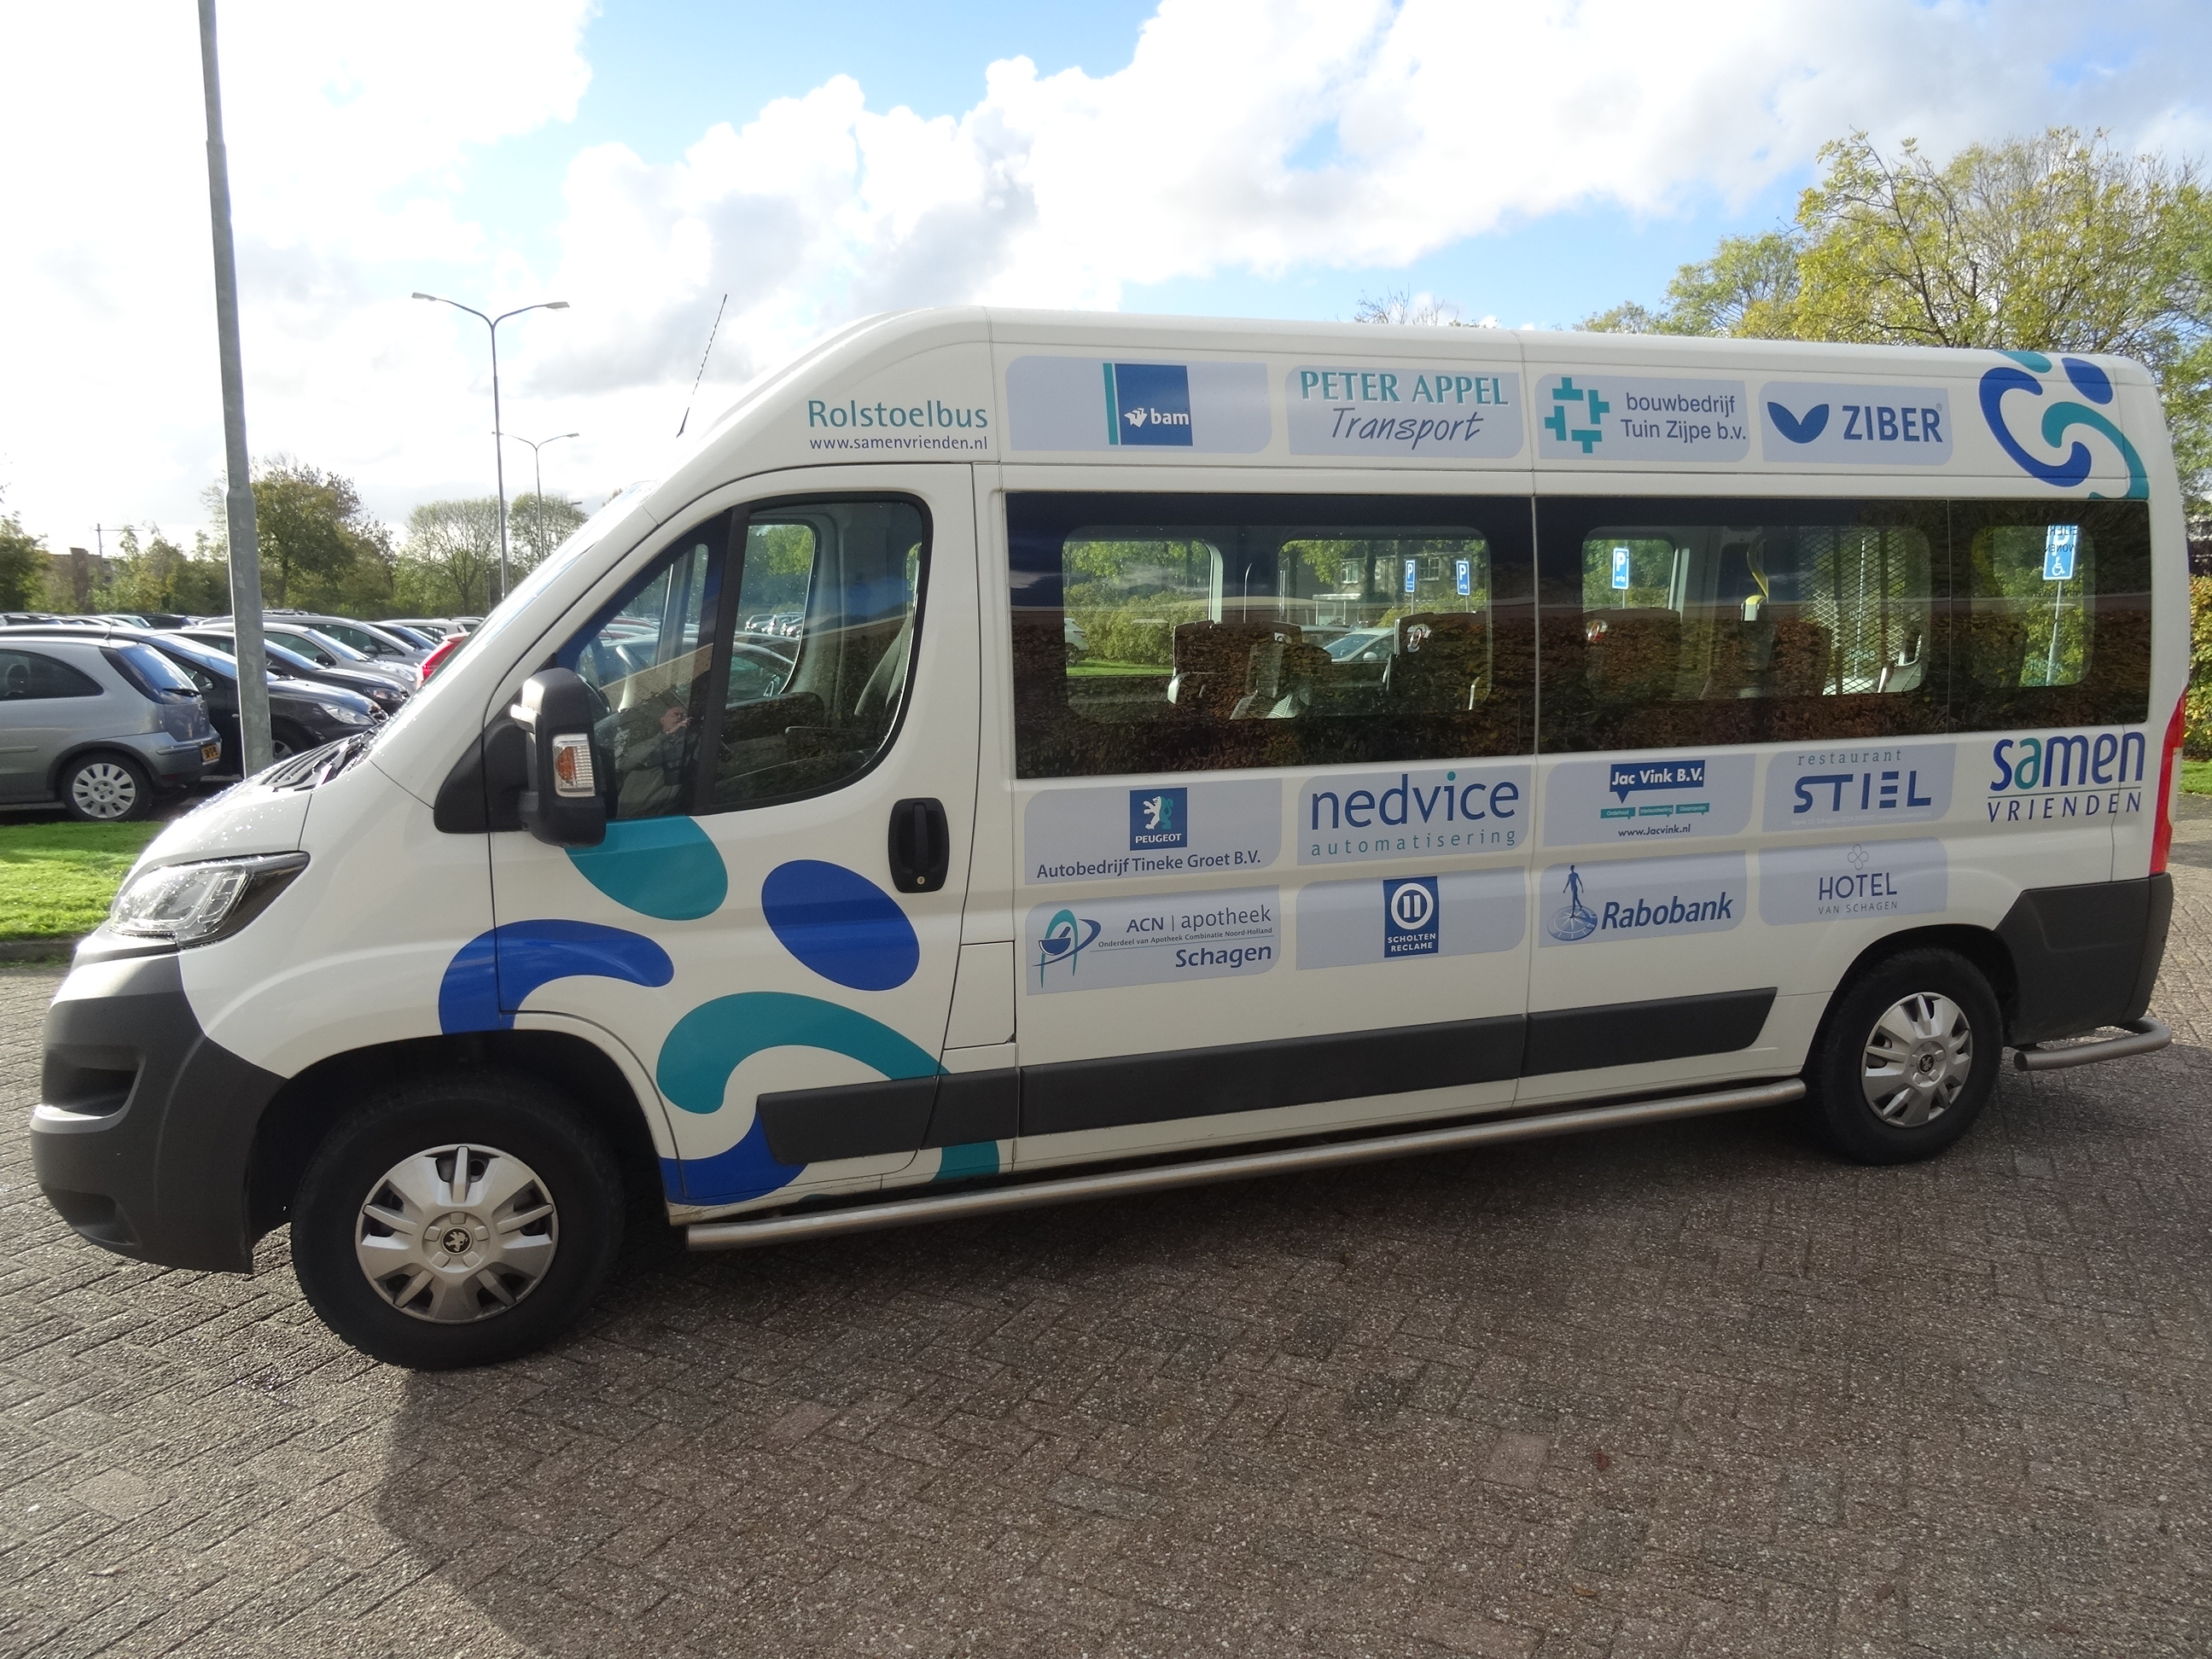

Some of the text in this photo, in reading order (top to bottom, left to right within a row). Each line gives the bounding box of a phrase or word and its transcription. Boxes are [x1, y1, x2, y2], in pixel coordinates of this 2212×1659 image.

[1300, 370, 1511, 406] PETER APPEL
[807, 399, 988, 428] Rolstoelbus
[1150, 407, 1190, 426] bam
[1625, 392, 1736, 419] bouwbedrijf
[1331, 407, 1484, 451] Transport
[1620, 418, 1747, 444] Tuin Zijpe b.v.
[1841, 404, 1944, 443] ZIBER
[809, 435, 988, 451] www.samenvrienden.nl
[1407, 563, 1413, 579] P
[1458, 564, 1467, 581] P
[1615, 551, 1626, 573] P
[1797, 749, 1901, 765] restaurant
[1989, 731, 2146, 792] samen
[1611, 767, 1703, 786] Jac Vink B.V.
[1311, 771, 1520, 830] nedvice
[1793, 771, 1932, 814] STIEL
[1988, 791, 2141, 823] VRIENDEN
[1135, 833, 1182, 844] PEUGEOT
[1311, 829, 1516, 857] automatisering
[1618, 824, 1691, 837] www.Jacvink.nl
[1037, 850, 1261, 878] Autobedrijf Tineke Groet B.V.
[1819, 872, 1898, 900] HOTEL
[1126, 905, 1272, 933] ACN apotheek
[1601, 892, 1734, 930] Rabobank
[1818, 901, 1898, 915] VAN SCHAGEN
[1098, 939, 1135, 947] Onderdeel
[1150, 934, 1183, 945] Apotheek
[1185, 931, 1223, 940] Combinatie
[1225, 927, 1272, 937] Noord-Holland
[1388, 933, 1436, 944] SCHOLTEN
[1391, 941, 1433, 952] RECLAME
[1175, 946, 1272, 969] Schagen
